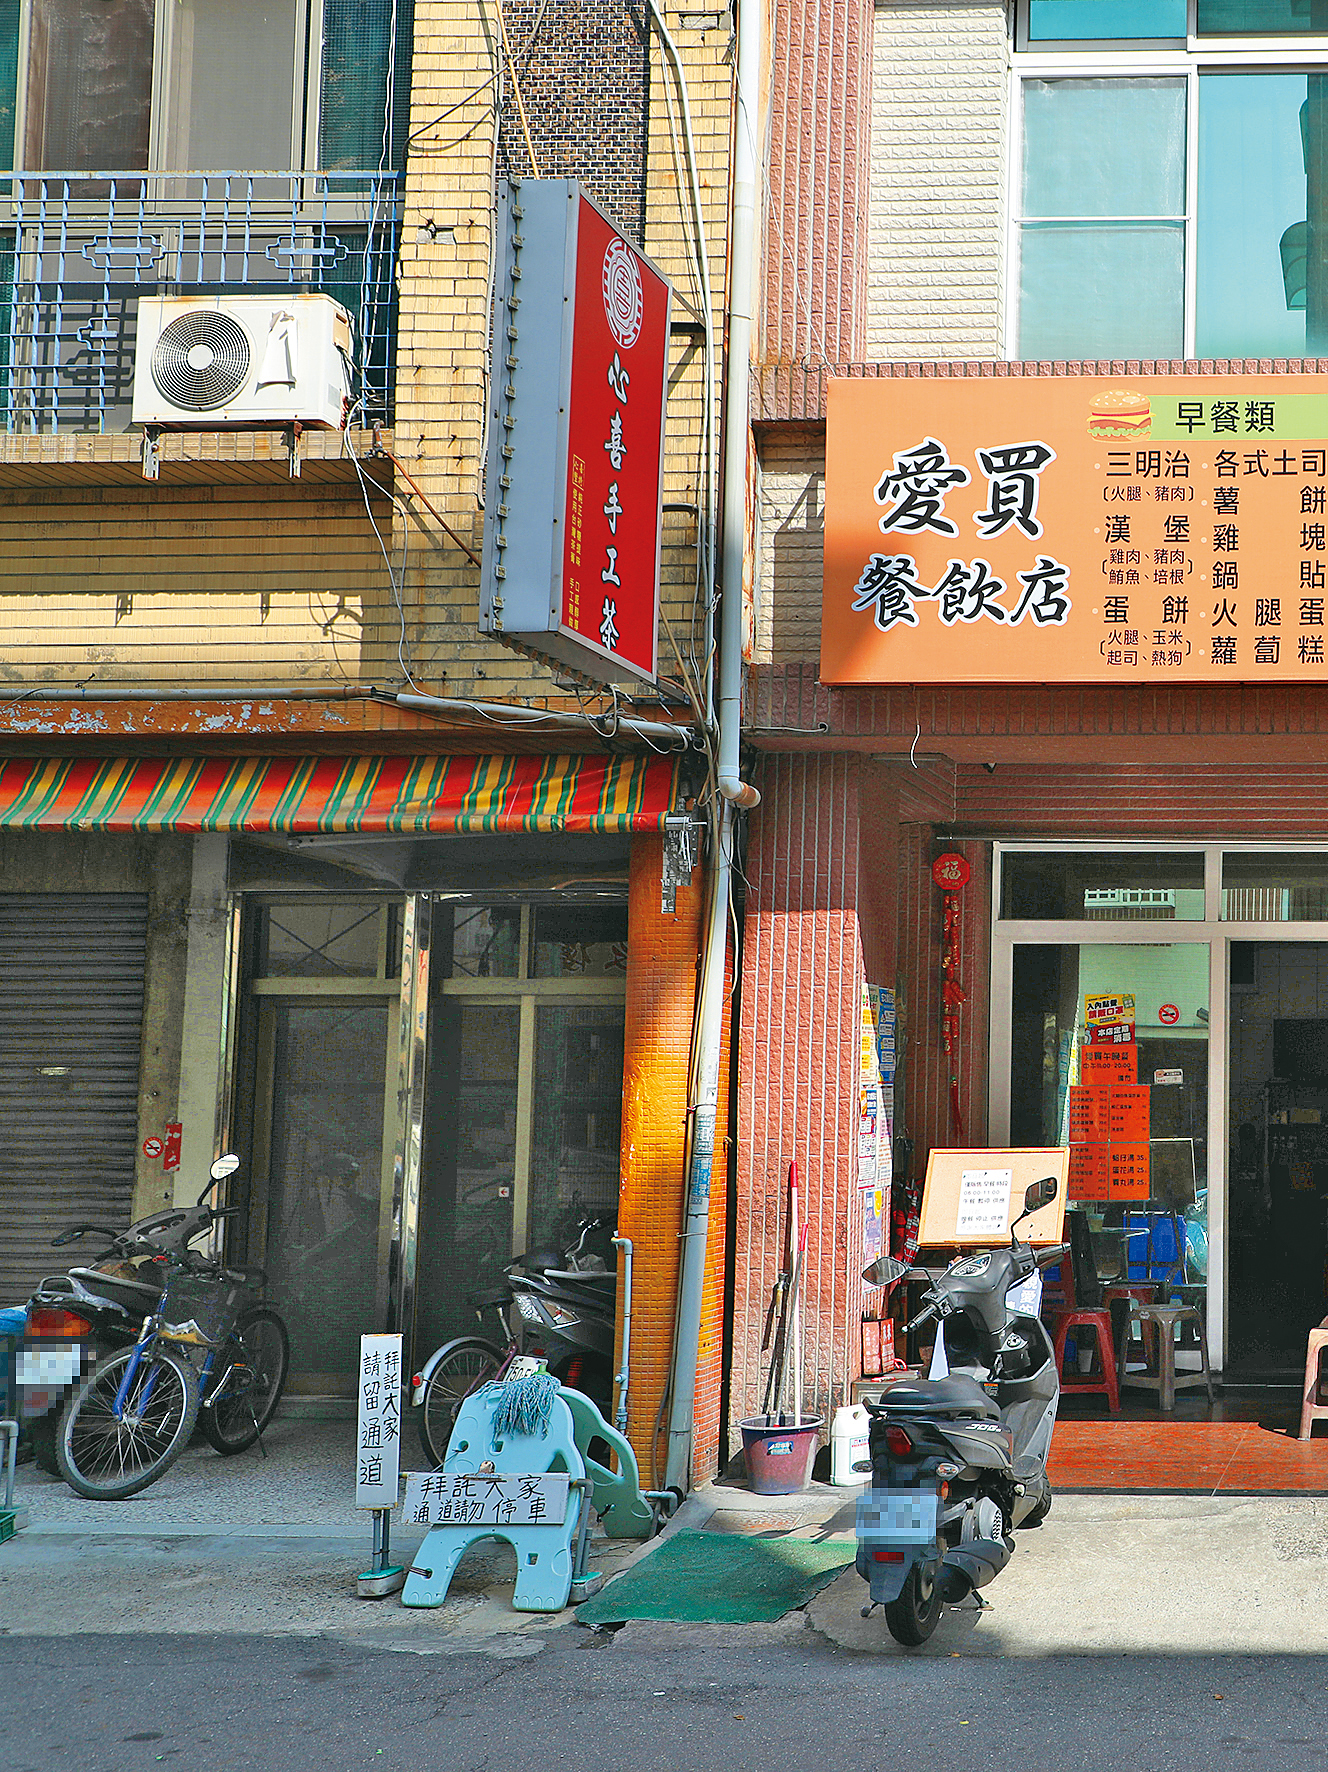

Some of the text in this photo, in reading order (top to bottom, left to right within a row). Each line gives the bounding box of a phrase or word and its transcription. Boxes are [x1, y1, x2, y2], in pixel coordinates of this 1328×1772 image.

[1176, 401, 1275, 433] 早餐類
[1106, 450, 1190, 478] 三明治
[1214, 449, 1325, 478] 各式土司
[599, 349, 631, 653] 心喜手工茶
[878, 441, 1051, 536] 愛買
[1214, 486, 1326, 515] 薯餅
[1105, 515, 1189, 543] 漢堡
[1213, 523, 1325, 552] 雞塊
[1212, 560, 1326, 589] 鍋貼
[853, 557, 1068, 627] 餐飲店
[1104, 596, 1189, 624] 蛋餅
[1212, 598, 1324, 627] 火腿蛋
[1211, 635, 1324, 665] 蘿蔔糕
[941, 861, 962, 880] 福
[383, 1350, 400, 1442] 拜託大家
[359, 1350, 383, 1487] 請留通道
[420, 1475, 545, 1500] 拜託大家
[413, 1498, 547, 1523] 通道請勿停車
